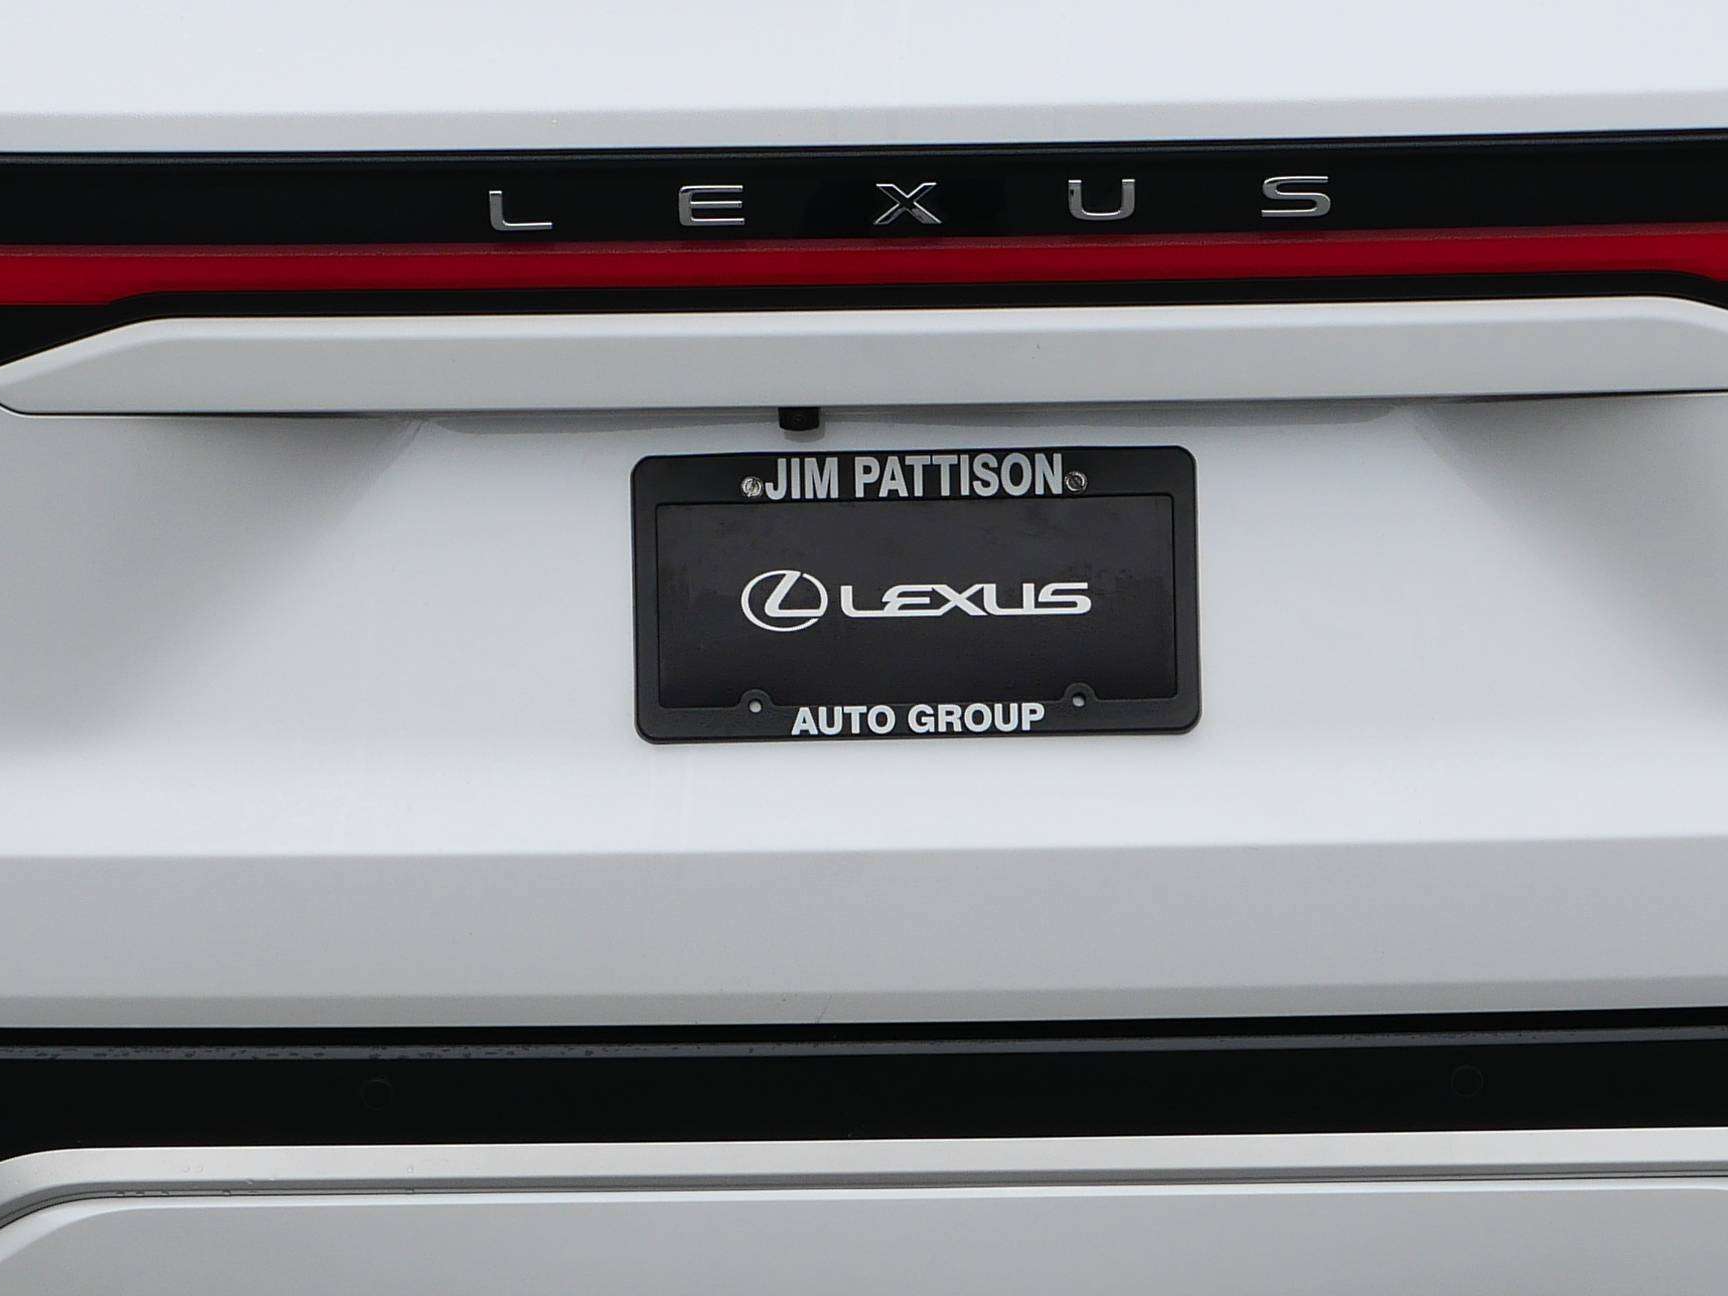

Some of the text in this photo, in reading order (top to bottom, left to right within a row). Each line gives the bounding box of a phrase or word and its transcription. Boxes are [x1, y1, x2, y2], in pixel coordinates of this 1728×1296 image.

[488, 174, 1332, 232] LEXUS
[765, 452, 1063, 499] JIM PATTISON
[841, 581, 1092, 618] LEXUS
[791, 703, 1046, 736] AUTO GROUP
